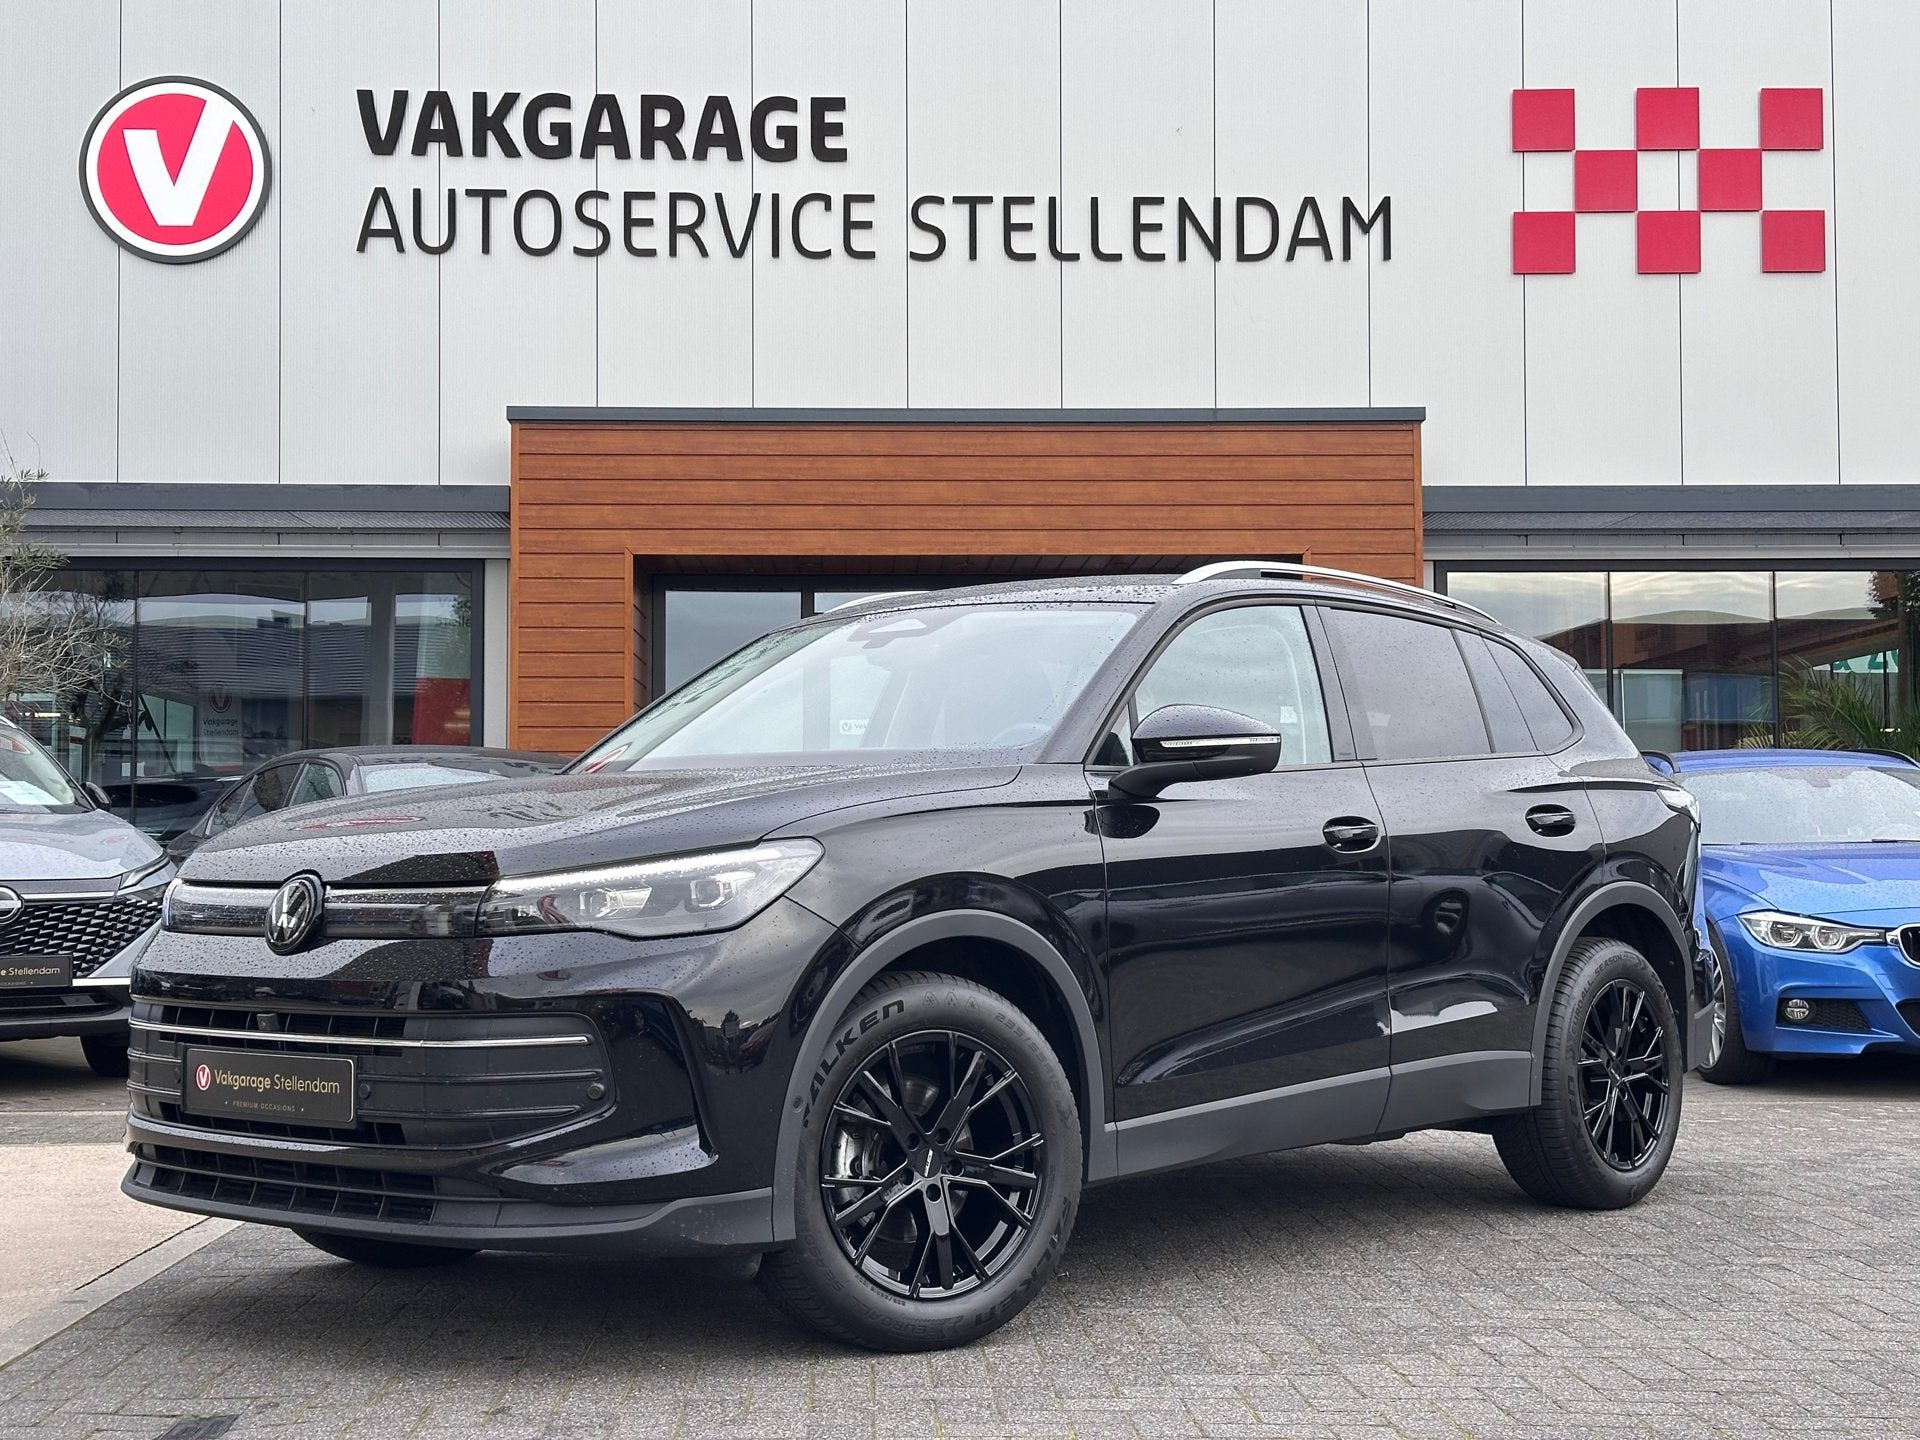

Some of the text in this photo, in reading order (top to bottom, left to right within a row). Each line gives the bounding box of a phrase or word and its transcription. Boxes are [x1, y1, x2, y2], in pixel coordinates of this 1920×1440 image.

[357, 90, 848, 163] VAKGARAGE
[122, 97, 236, 227] V
[357, 187, 1392, 263] AUTOSERVICE STELLENDAM
[8, 966, 61, 976] Stellendam
[214, 1069, 271, 1093] Vakgarage
[273, 1073, 340, 1094] Stellendam
[232, 1100, 296, 1113] PREMIUM OCCASIONS
